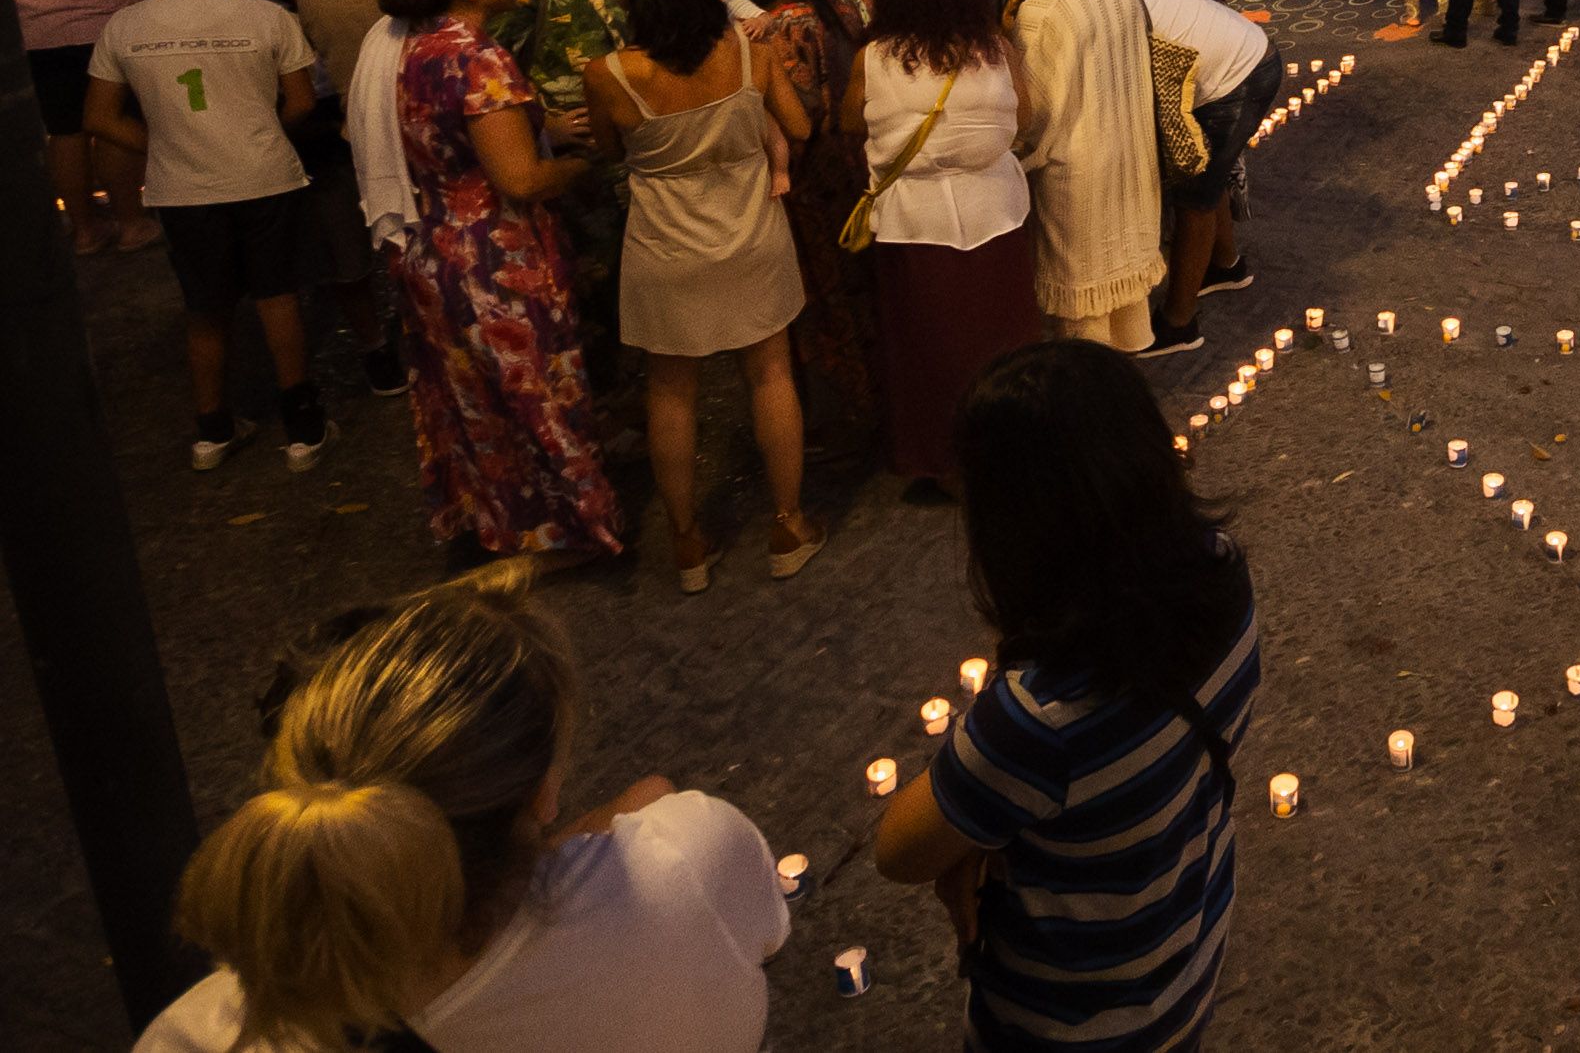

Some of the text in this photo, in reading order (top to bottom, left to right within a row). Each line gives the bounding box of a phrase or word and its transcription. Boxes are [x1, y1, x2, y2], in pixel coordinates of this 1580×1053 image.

[131, 39, 252, 53] SPORT FOR GOOD
[176, 68, 208, 112] 1
